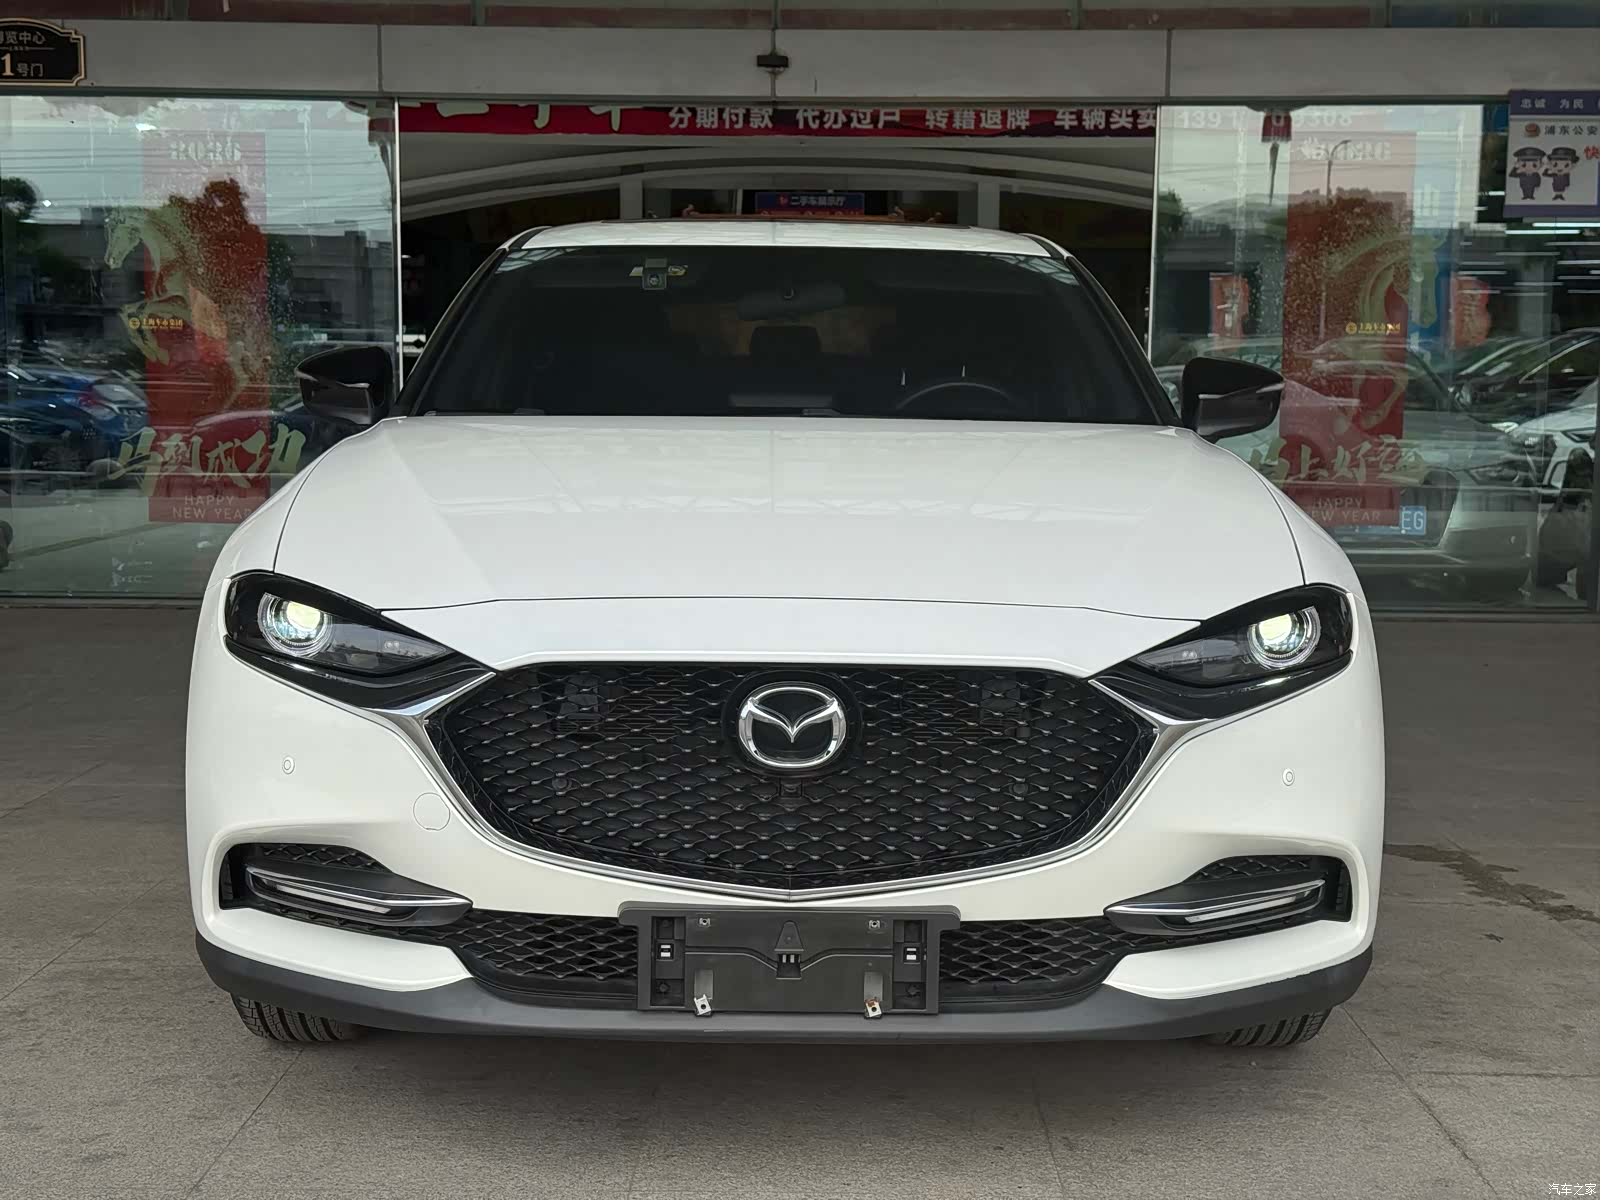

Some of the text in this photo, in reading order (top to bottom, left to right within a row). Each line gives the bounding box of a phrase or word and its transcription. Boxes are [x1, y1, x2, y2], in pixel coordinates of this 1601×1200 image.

[1560, 98, 1584, 109] 为民
[668, 105, 774, 130] 分期付款
[796, 107, 901, 130] 代办过户
[924, 107, 1031, 131] 转籍退牌
[1054, 107, 1157, 131] 车辆买卖
[1544, 125, 1598, 136] 浦东公安
[184, 495, 235, 506] HAPPY
[172, 507, 207, 520] NEW
[1342, 510, 1381, 521] YEAR
